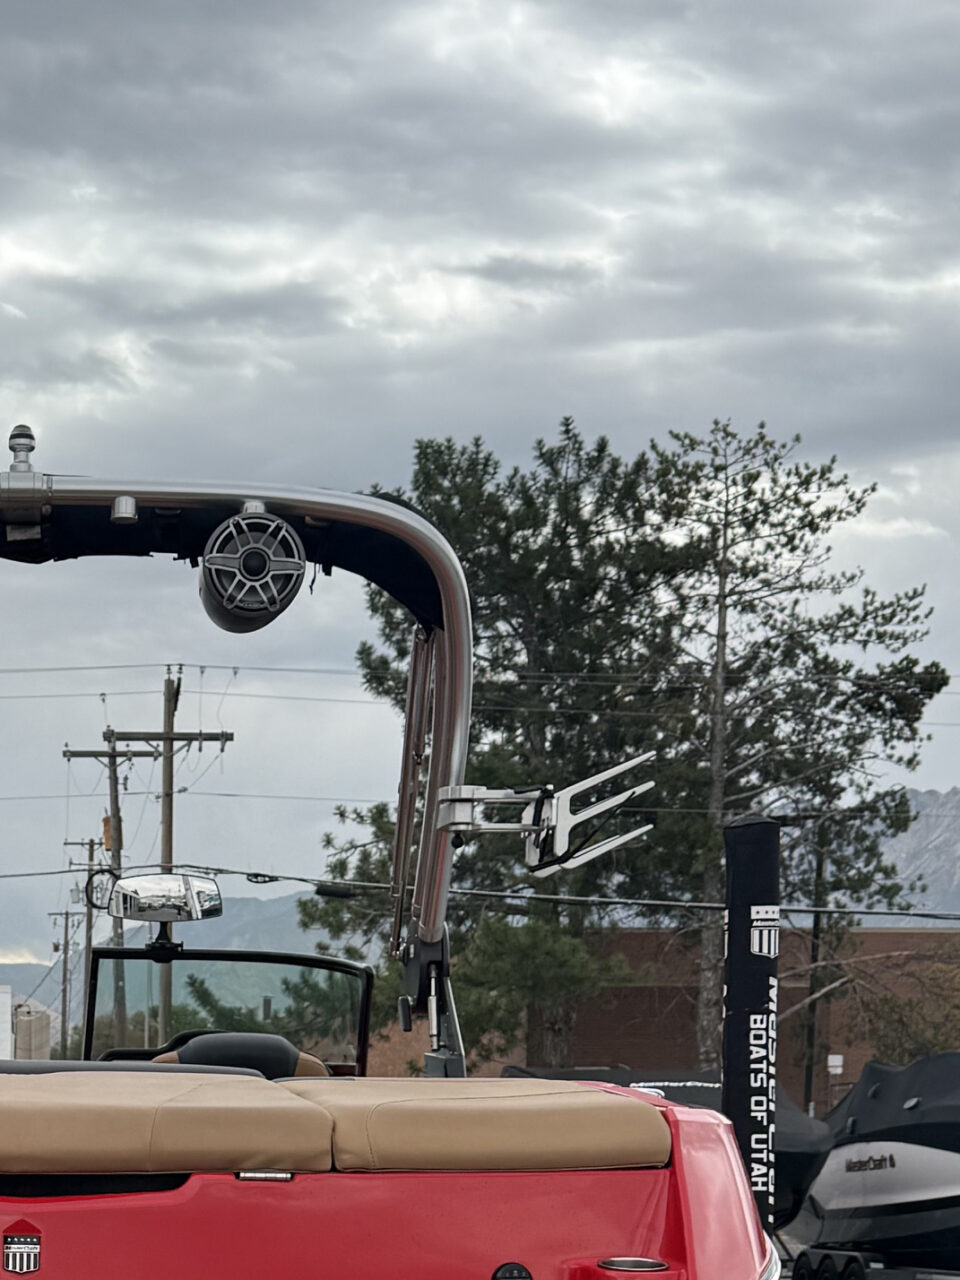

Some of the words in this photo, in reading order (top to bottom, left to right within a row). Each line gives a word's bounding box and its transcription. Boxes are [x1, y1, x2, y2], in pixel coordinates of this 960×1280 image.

[749, 1014, 767, 1088] BOATS
[750, 1096, 767, 1126] OF
[751, 1134, 768, 1191] UTAH
